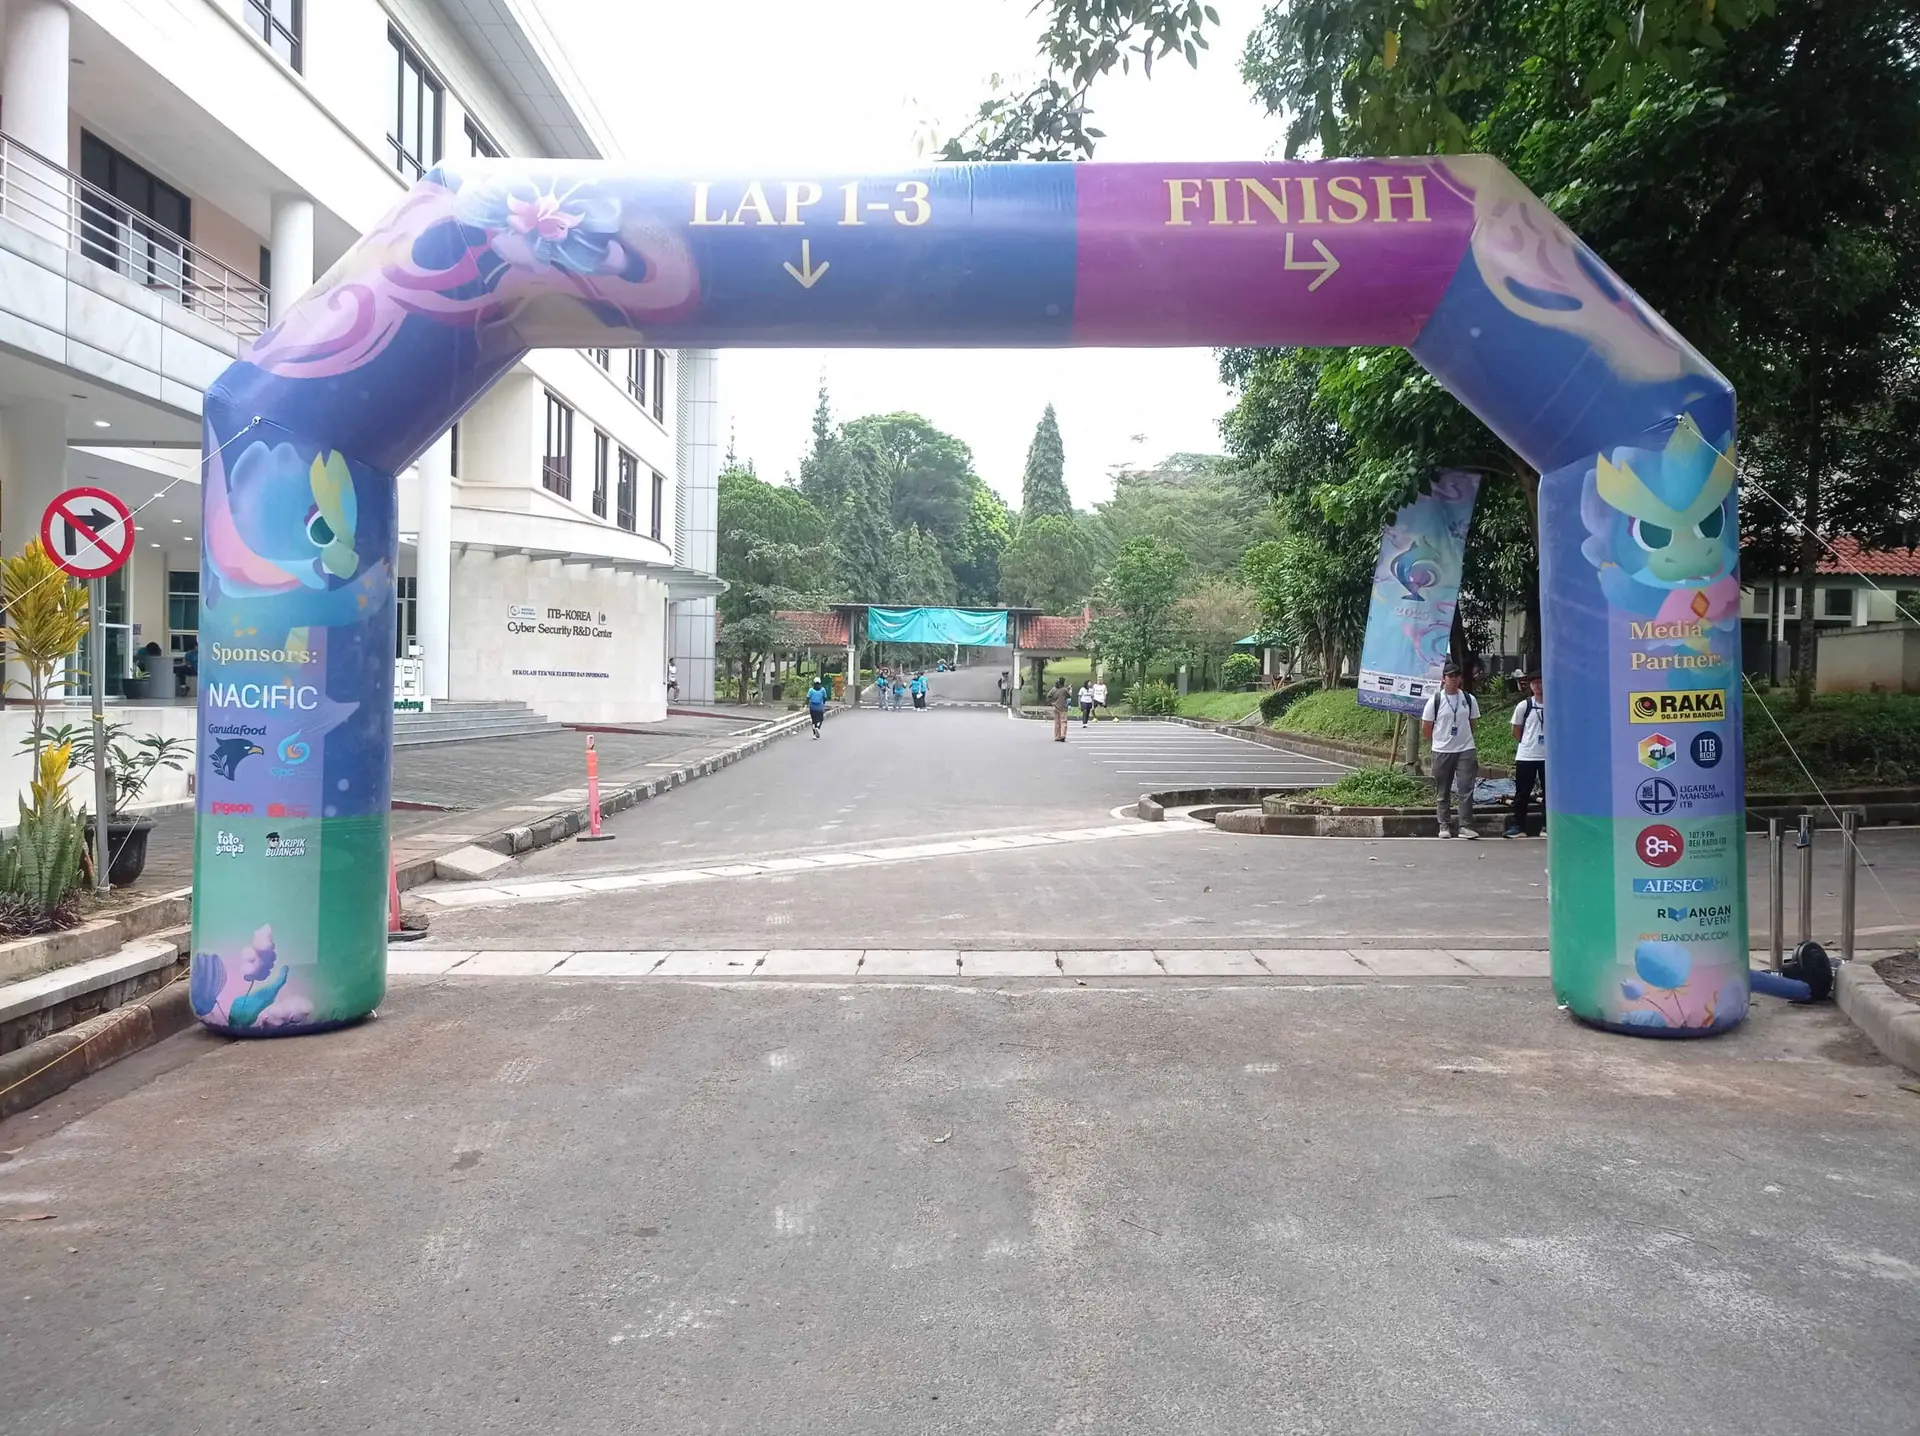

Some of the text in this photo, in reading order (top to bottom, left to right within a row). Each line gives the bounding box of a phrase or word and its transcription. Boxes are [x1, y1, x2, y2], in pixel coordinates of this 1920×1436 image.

[688, 180, 932, 227] LAP 1-3
[1162, 175, 1432, 226] FINISH
[547, 608, 592, 621] ITB-KOREA
[1394, 606, 1430, 620] 2025
[507, 621, 613, 638] Cyber Security R&D Center
[1629, 621, 1704, 640] Media
[211, 642, 317, 666] Sponsors:
[208, 682, 319, 710] NACIFIC
[1660, 693, 1723, 713] RAKA
[1692, 711, 1724, 719] BANDUNG
[1699, 738, 1716, 752] ITB
[1680, 790, 1725, 800] MAHASISWA
[212, 801, 254, 815] pigeon
[1680, 801, 1693, 809] ITB
[217, 830, 240, 845] foto
[278, 838, 307, 848] KRIPIK
[215, 842, 245, 858] snaps
[265, 847, 306, 858] BUJANGAN
[1642, 878, 1704, 893] AIESEC
[1699, 915, 1731, 927] EVENT
